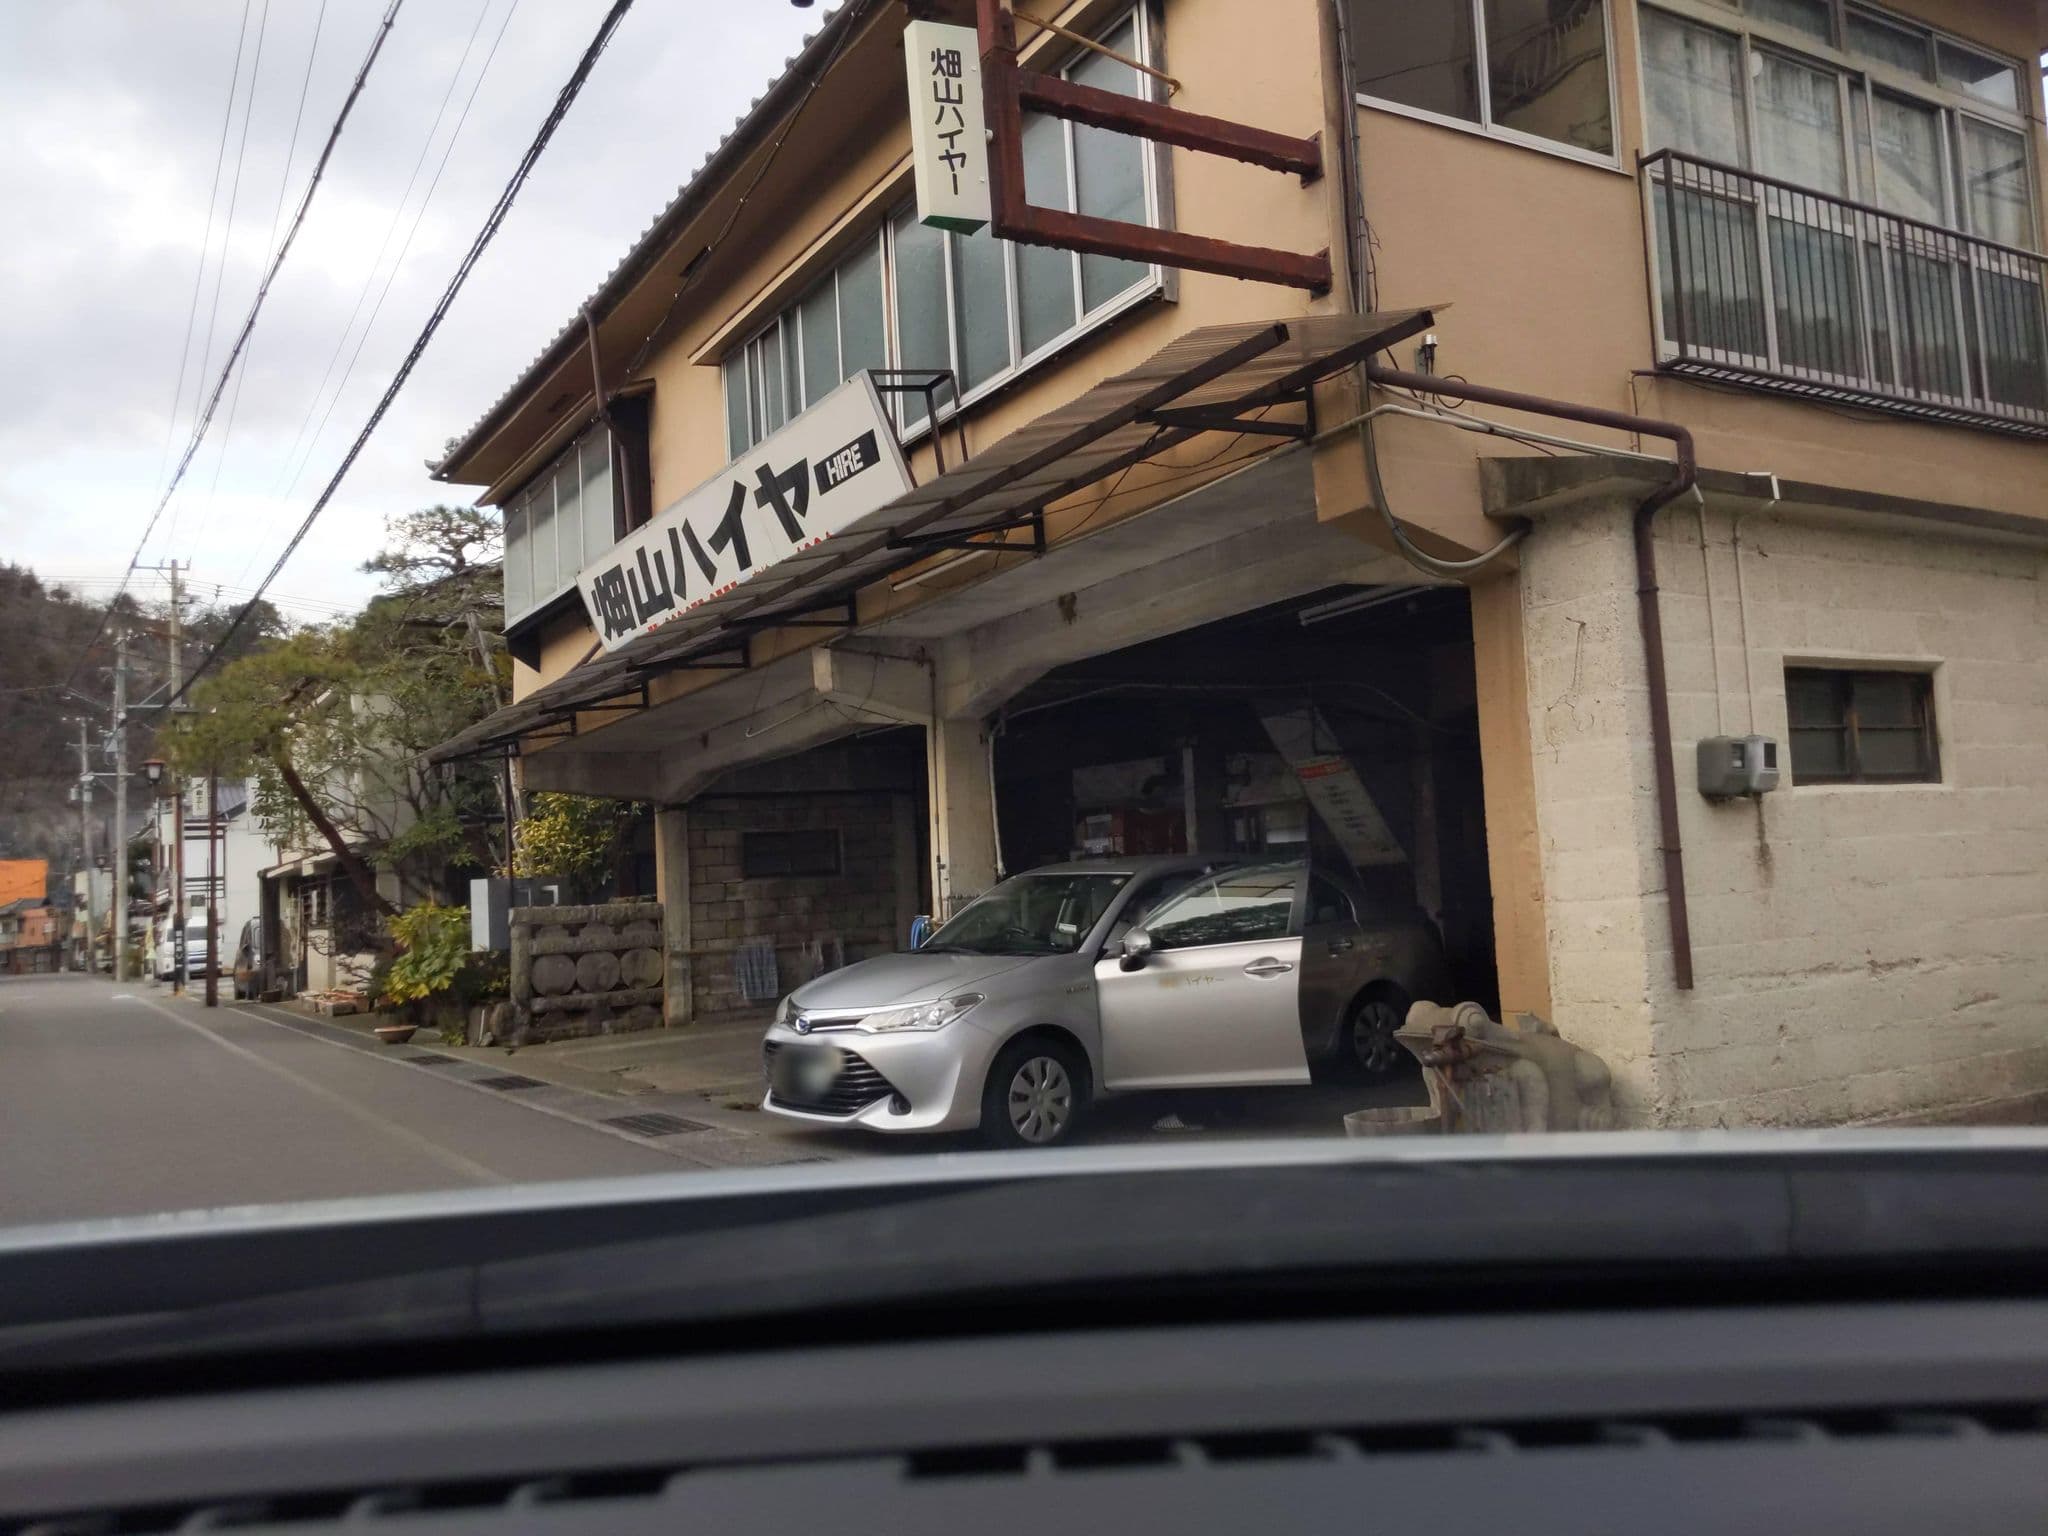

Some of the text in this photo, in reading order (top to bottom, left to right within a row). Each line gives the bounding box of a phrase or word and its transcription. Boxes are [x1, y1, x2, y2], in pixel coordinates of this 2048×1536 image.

[930, 47, 967, 196] 畑山ハイヤー
[826, 443, 864, 486] HIRE
